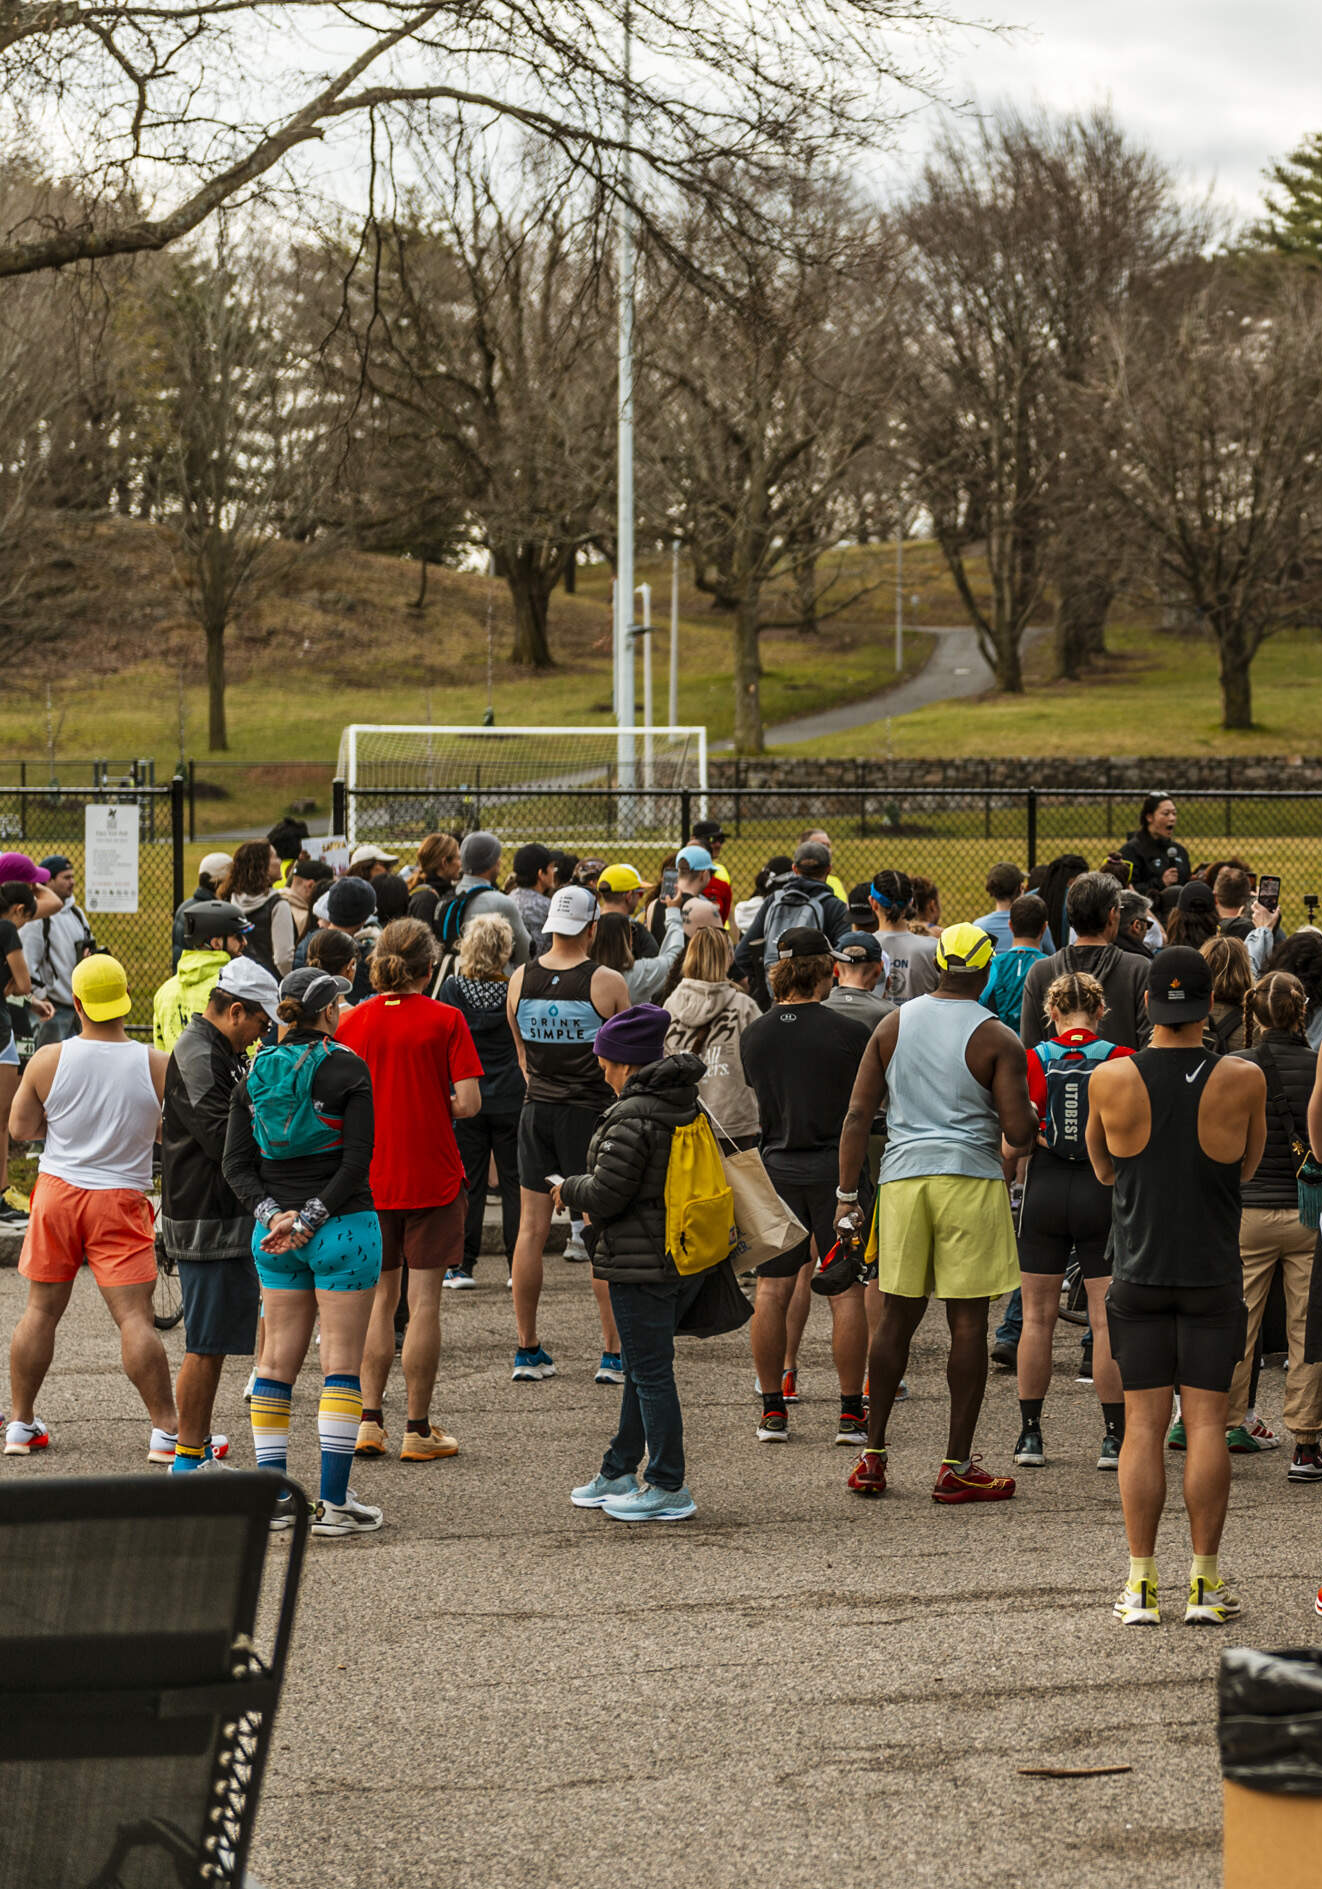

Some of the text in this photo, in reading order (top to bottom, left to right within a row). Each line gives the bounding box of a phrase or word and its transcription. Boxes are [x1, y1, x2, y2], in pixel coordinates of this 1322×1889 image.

[530, 1017, 580, 1027] DRINK
[529, 1028, 585, 1040] SIMPLE
[1064, 1083, 1079, 1142] UTOBEST
